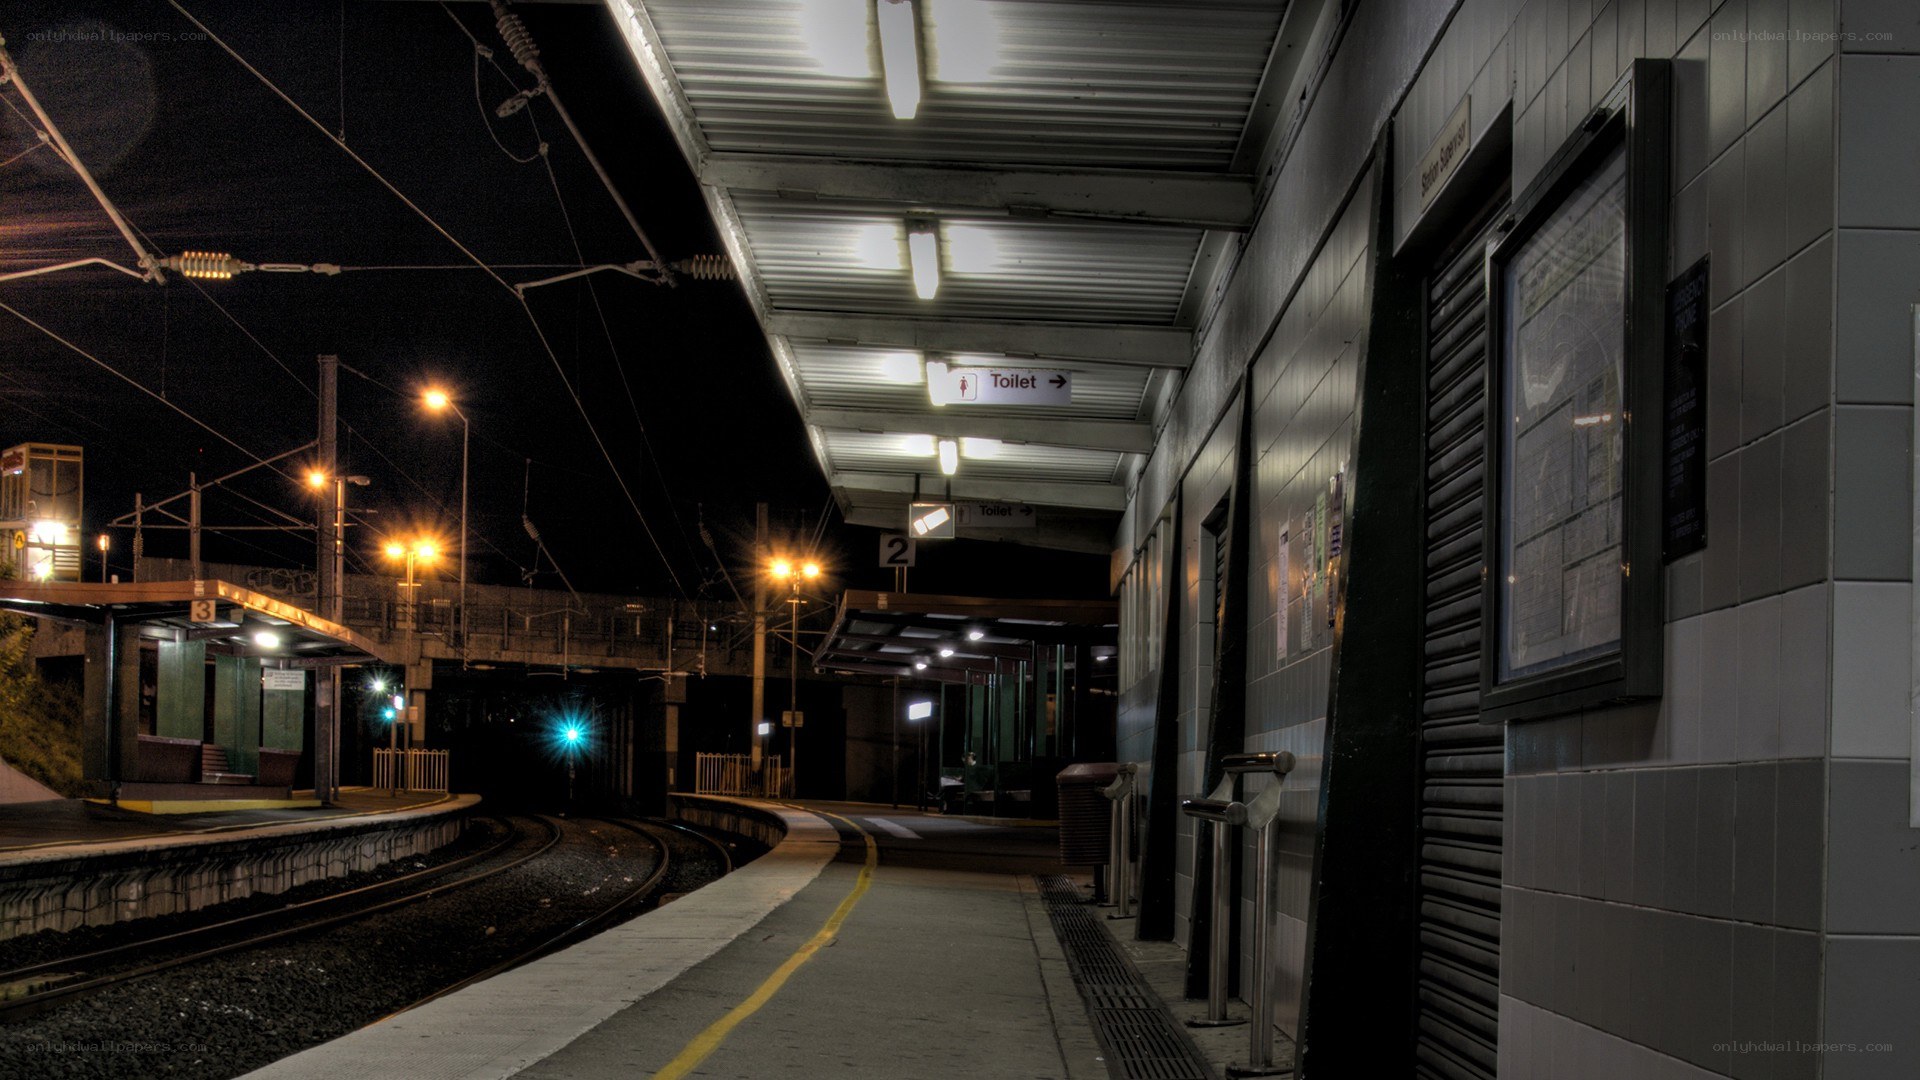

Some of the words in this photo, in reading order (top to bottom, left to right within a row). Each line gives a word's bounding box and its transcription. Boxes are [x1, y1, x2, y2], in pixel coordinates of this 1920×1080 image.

[990, 373, 1037, 389] Toilet
[979, 504, 1012, 517] Toilet
[887, 537, 908, 564] 2
[196, 601, 211, 620] 3
